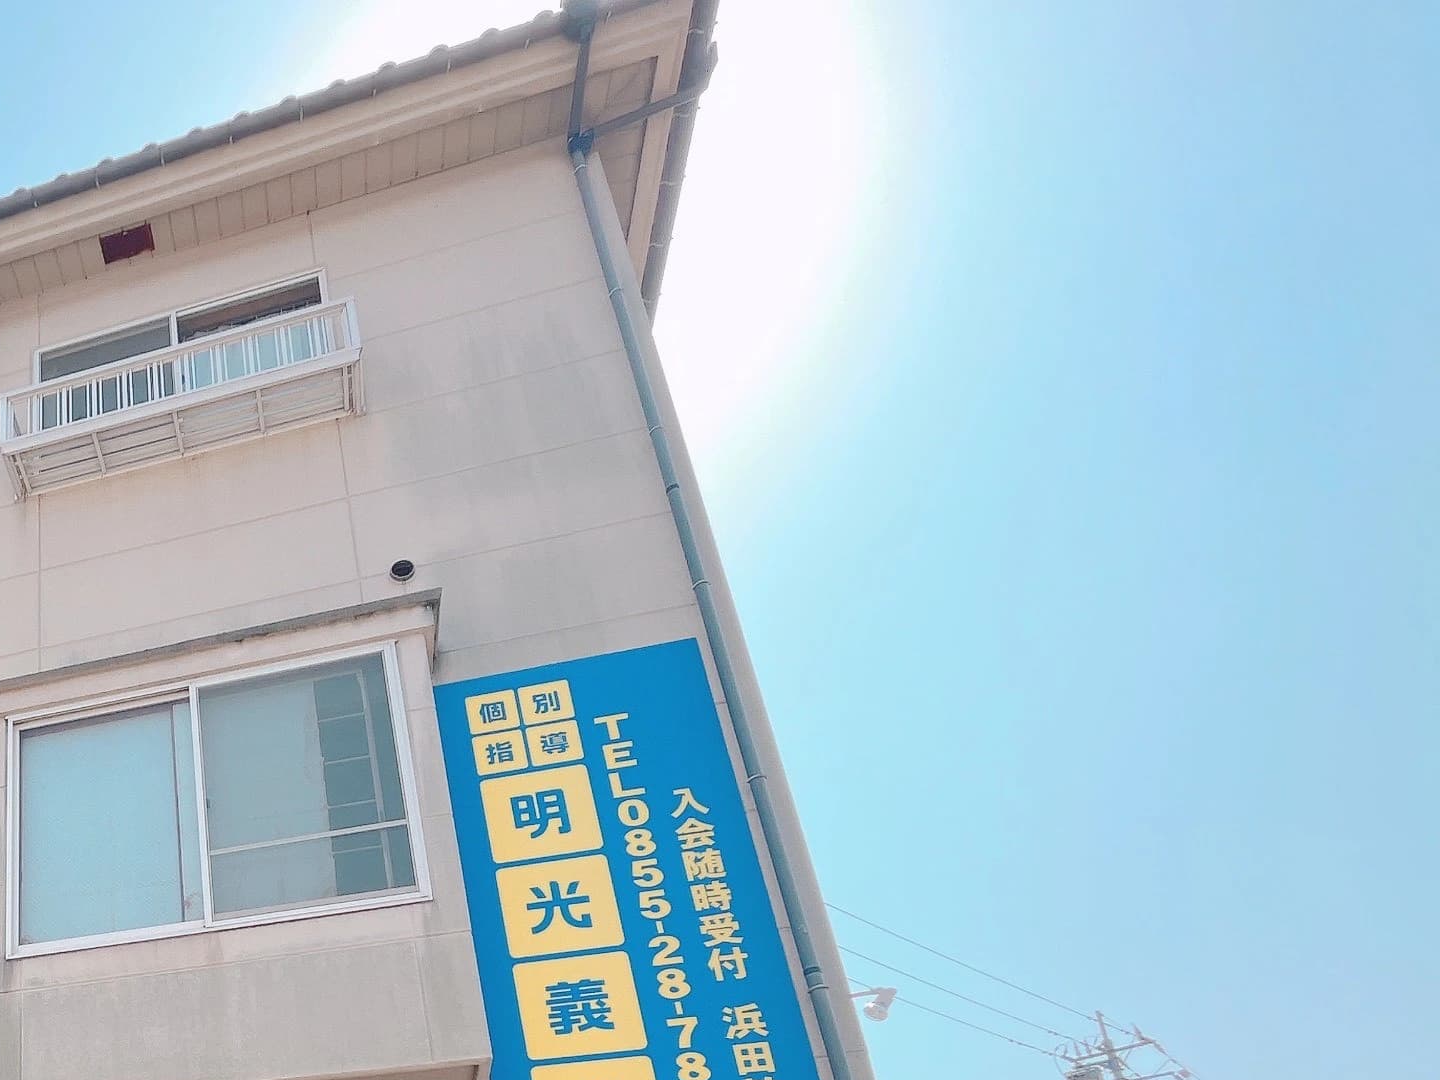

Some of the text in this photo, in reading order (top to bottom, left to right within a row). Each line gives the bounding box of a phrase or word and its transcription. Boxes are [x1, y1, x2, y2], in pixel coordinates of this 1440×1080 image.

[479, 690, 562, 724] 個別
[486, 731, 570, 765] 指導
[671, 787, 750, 982] 入会随時受付
